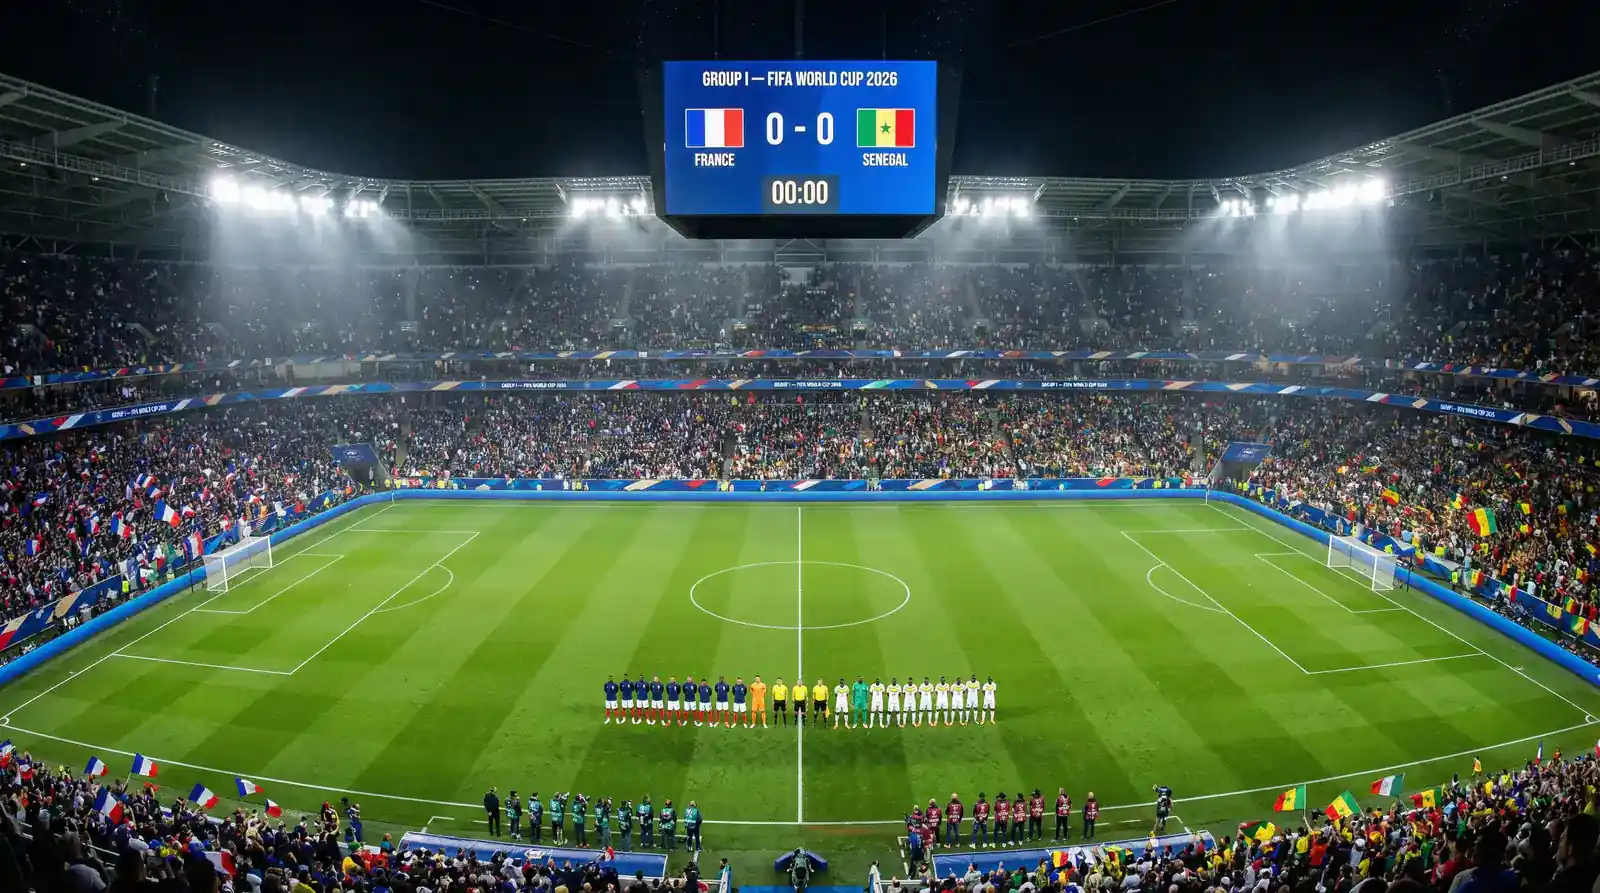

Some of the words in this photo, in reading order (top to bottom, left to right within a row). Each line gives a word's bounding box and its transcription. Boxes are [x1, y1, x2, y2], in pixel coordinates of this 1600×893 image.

[703, 71, 743, 87] GROUP
[745, 71, 749, 87] I
[767, 71, 793, 87] FIFA
[796, 71, 838, 87] WORLD
[840, 71, 864, 87] CUP
[867, 71, 898, 87] 2026
[766, 112, 784, 146] 0
[817, 112, 834, 146] 0
[694, 153, 735, 167] FRANCE
[862, 153, 909, 167] SENEGAL
[771, 180, 829, 205] 00:00
